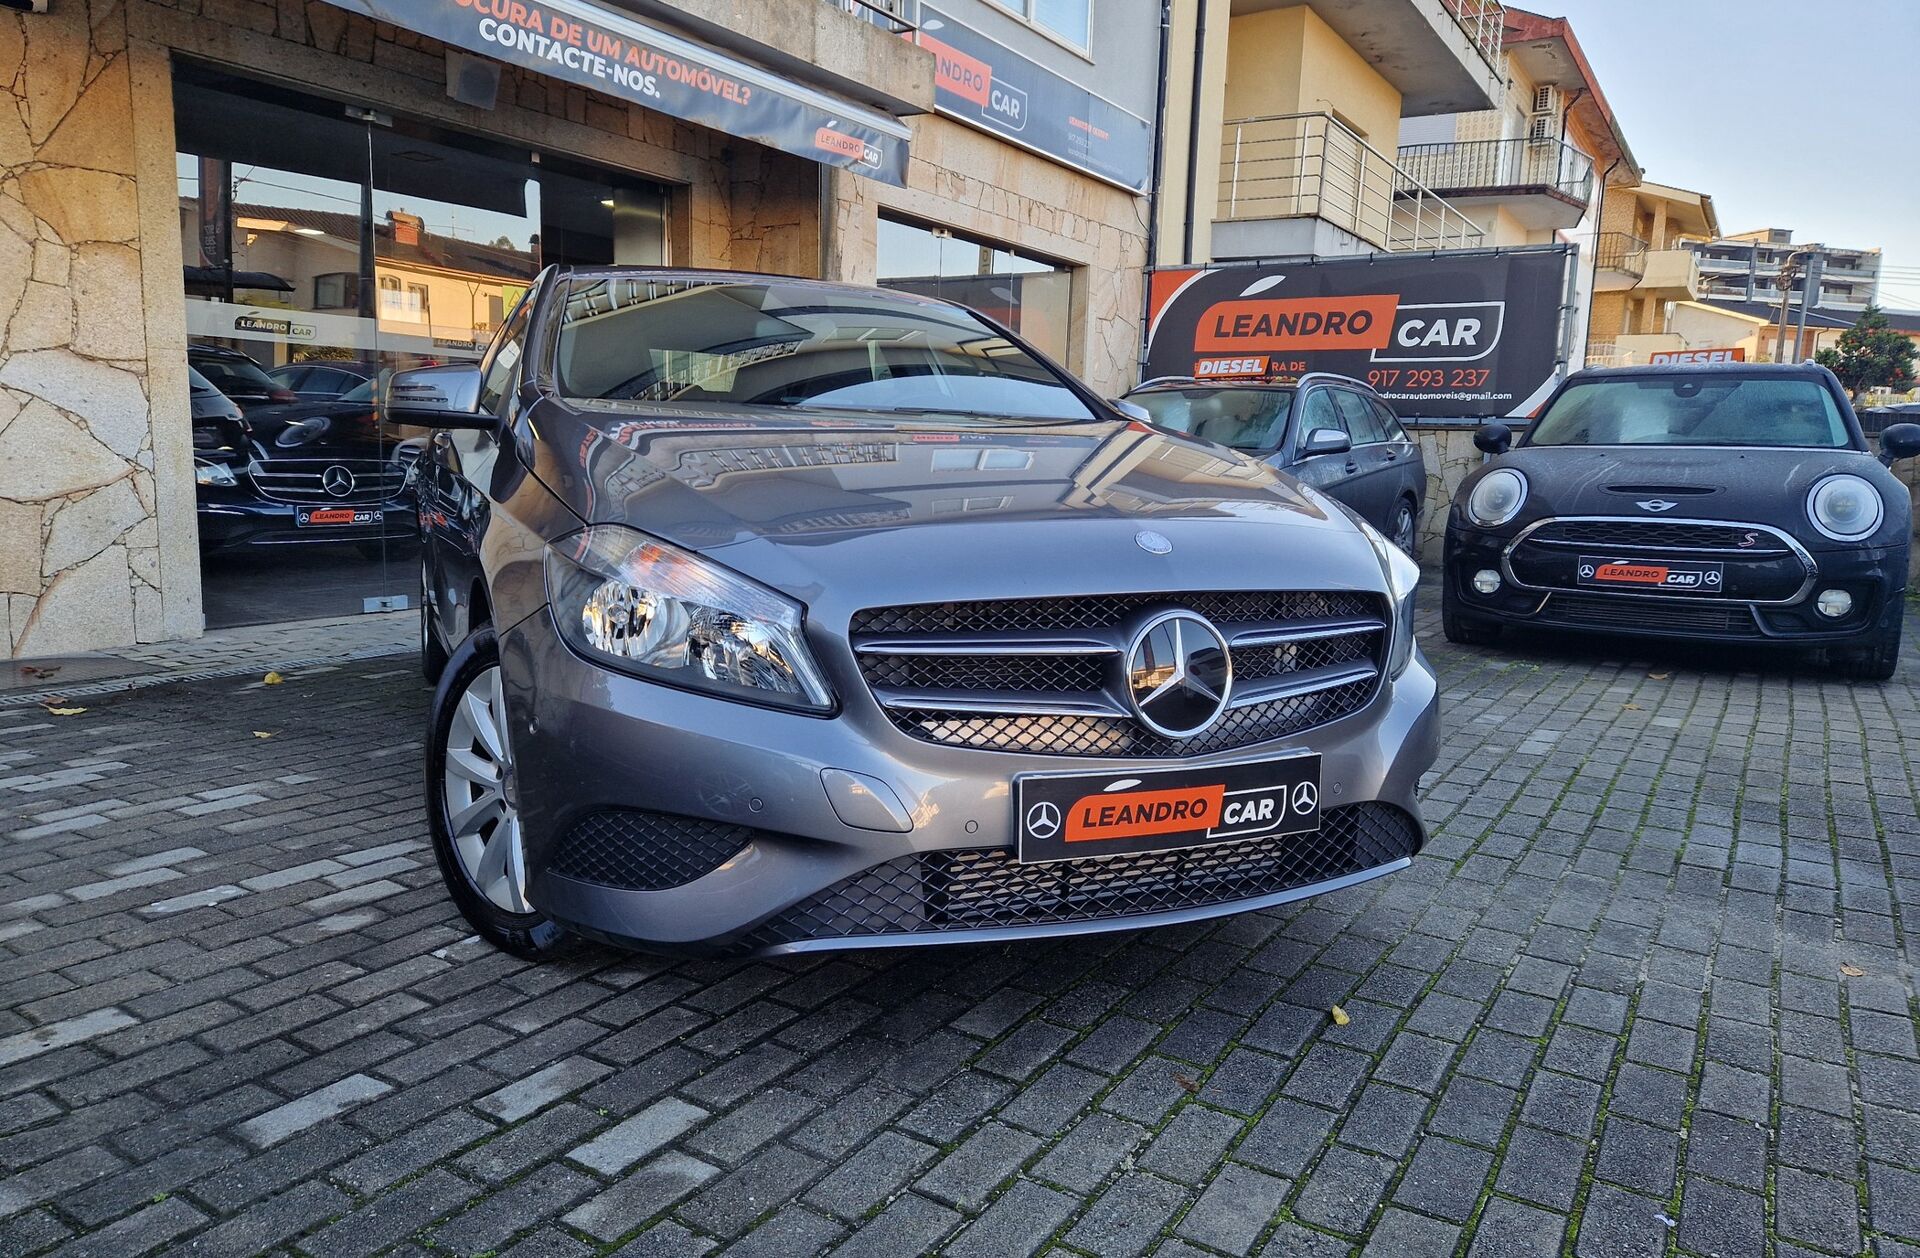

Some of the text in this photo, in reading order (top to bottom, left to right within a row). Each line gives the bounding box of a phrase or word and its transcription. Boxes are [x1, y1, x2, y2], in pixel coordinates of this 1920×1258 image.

[479, 17, 661, 98] CONTACTE-NOS.
[550, 16, 583, 47] DE
[587, 30, 622, 60] UM
[624, 45, 752, 106] AUTOMÓVEL?
[935, 56, 1020, 119] NDRO CAR
[820, 134, 879, 164] LEANDRO CAR
[240, 319, 312, 336] LEANDRO CAR
[1213, 309, 1481, 348] LEANDRO CAR
[1199, 359, 1264, 375] DIESEL
[1290, 361, 1306, 371] DE
[1652, 350, 1738, 364] DIESEL
[1368, 370, 1490, 387] 917 293 237
[1603, 568, 1696, 584] LEANDRO CAR
[1082, 798, 1275, 828] LEANDRO CAR
